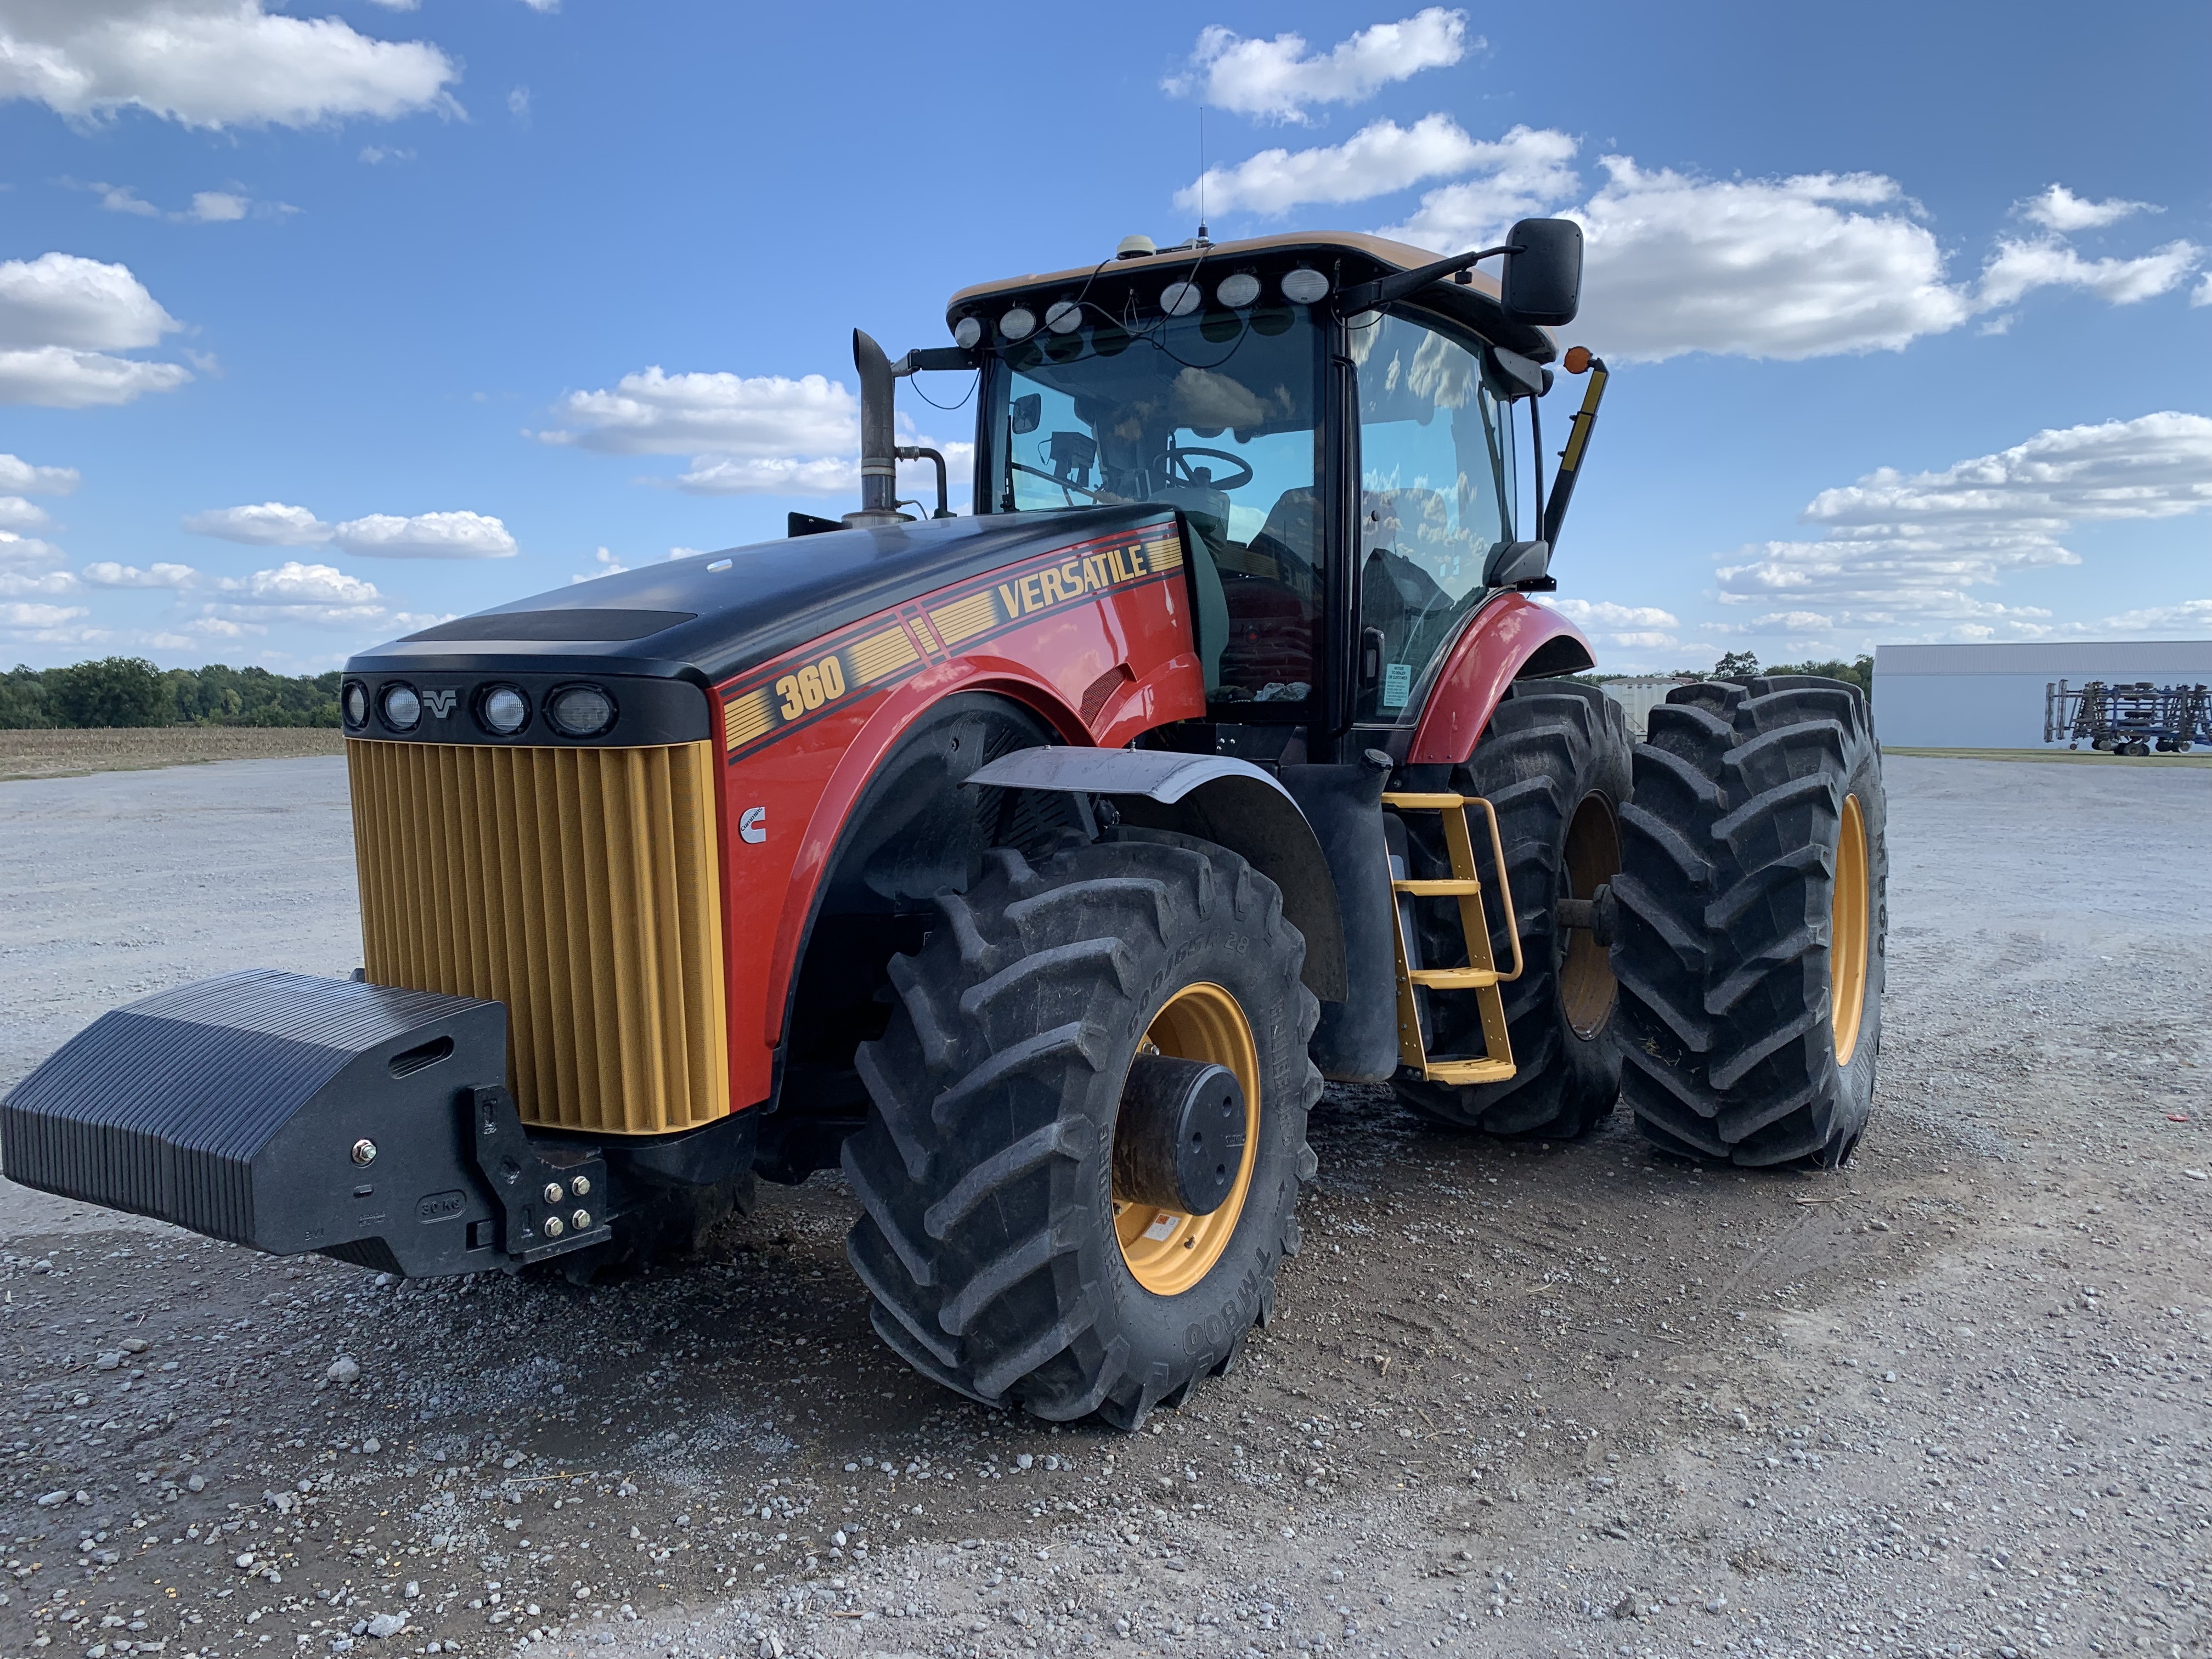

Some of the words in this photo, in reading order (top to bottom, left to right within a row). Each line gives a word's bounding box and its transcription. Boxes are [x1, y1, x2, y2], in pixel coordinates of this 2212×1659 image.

[998, 545, 1147, 619] VERSATILE
[776, 656, 845, 720] 360
[741, 807, 763, 831] Cummins
[1223, 930, 1250, 955] 28
[1183, 1246, 1273, 1356] TM800
